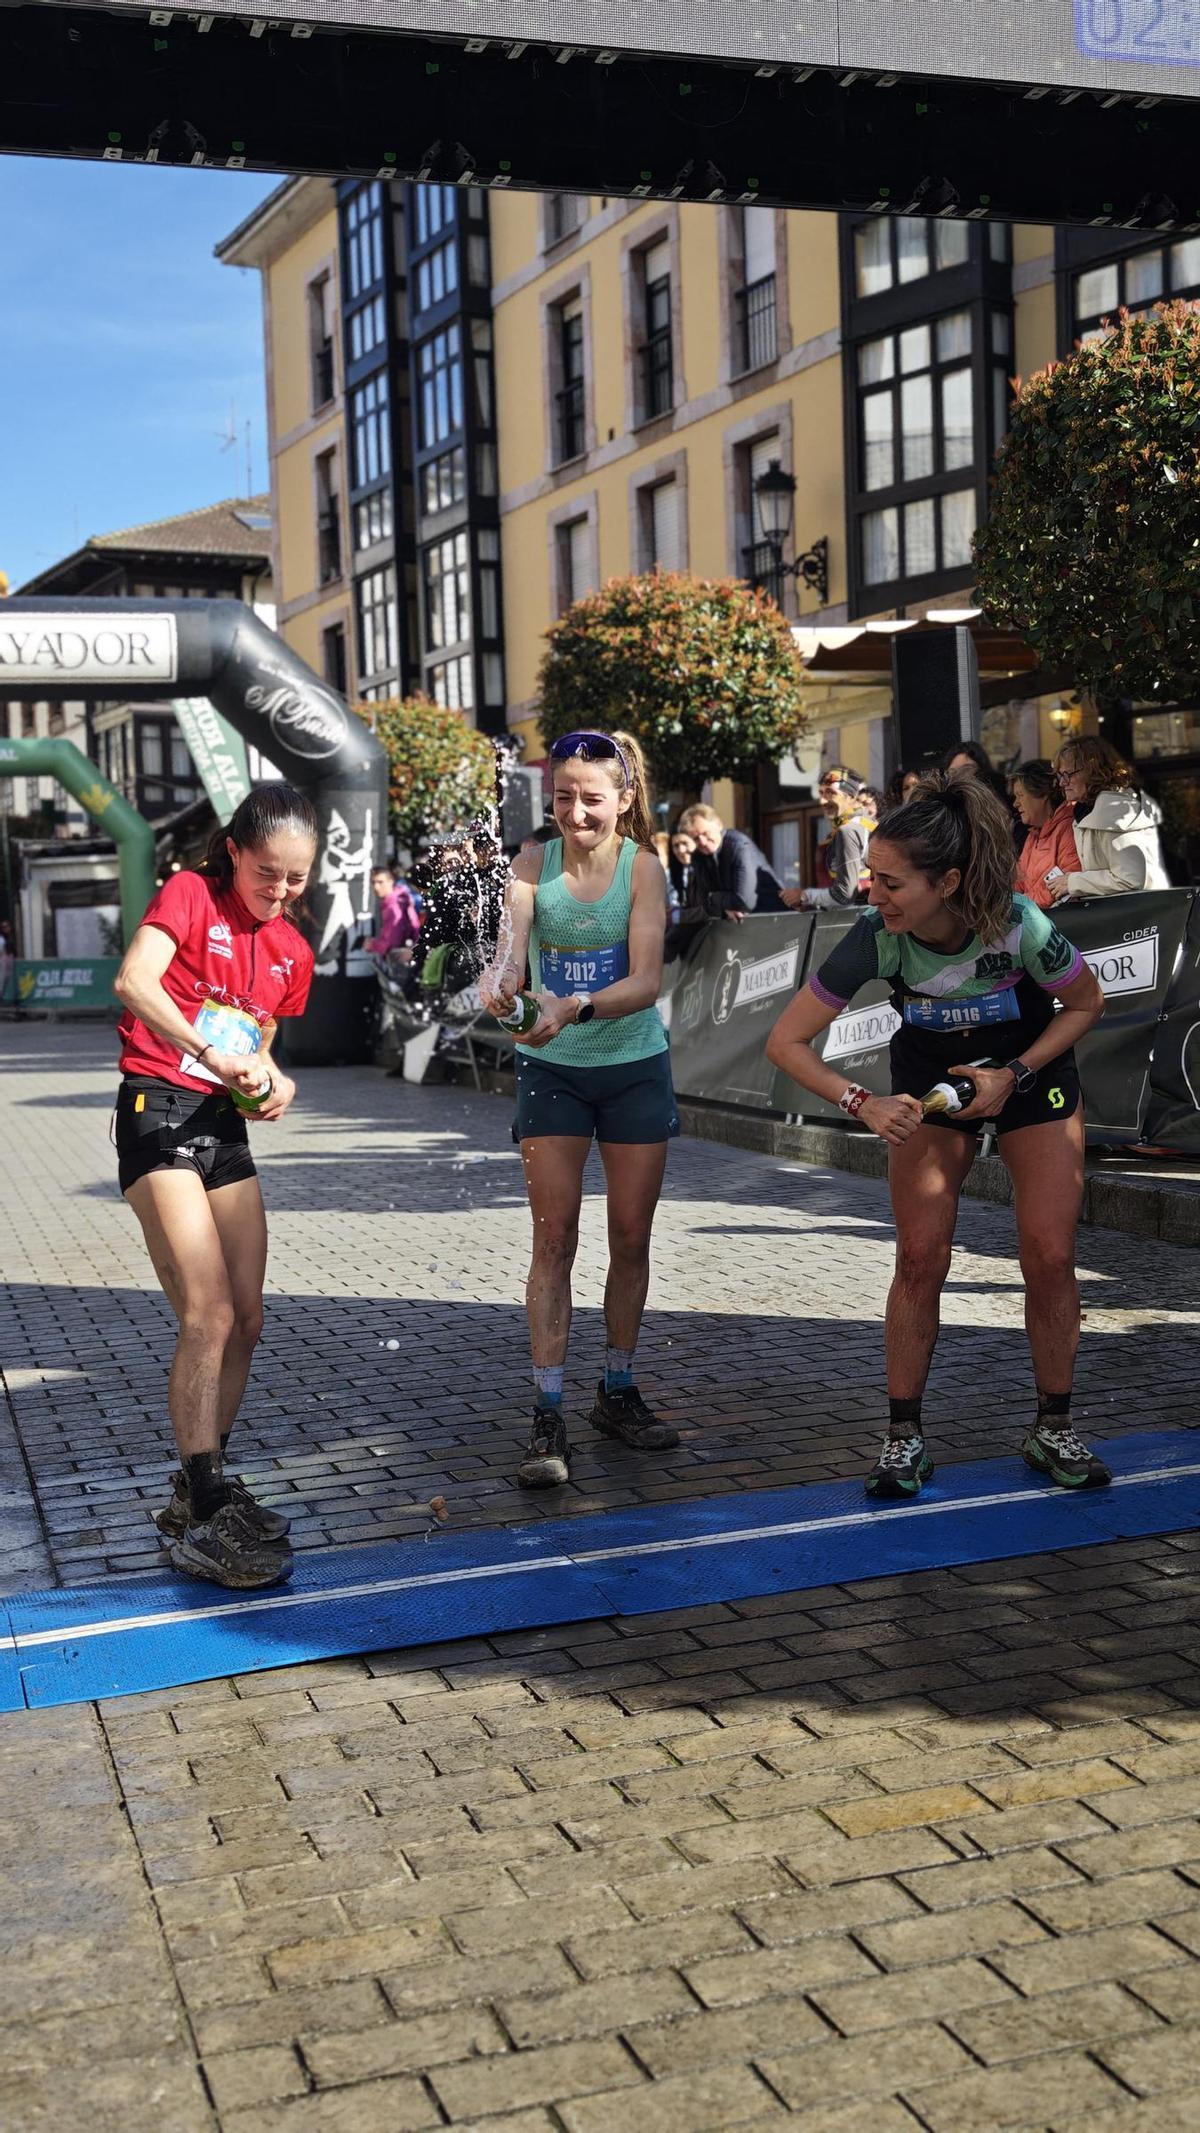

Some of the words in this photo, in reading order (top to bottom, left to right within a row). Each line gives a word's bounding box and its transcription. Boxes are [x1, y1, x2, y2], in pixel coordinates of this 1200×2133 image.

[0, 632, 156, 670] YADOR
[1122, 925, 1158, 941] CIDER
[564, 961, 597, 982] 2012
[743, 961, 789, 994] MAYADOR
[942, 1006, 980, 1023] 2016
[834, 1012, 897, 1047] MAYADOR
